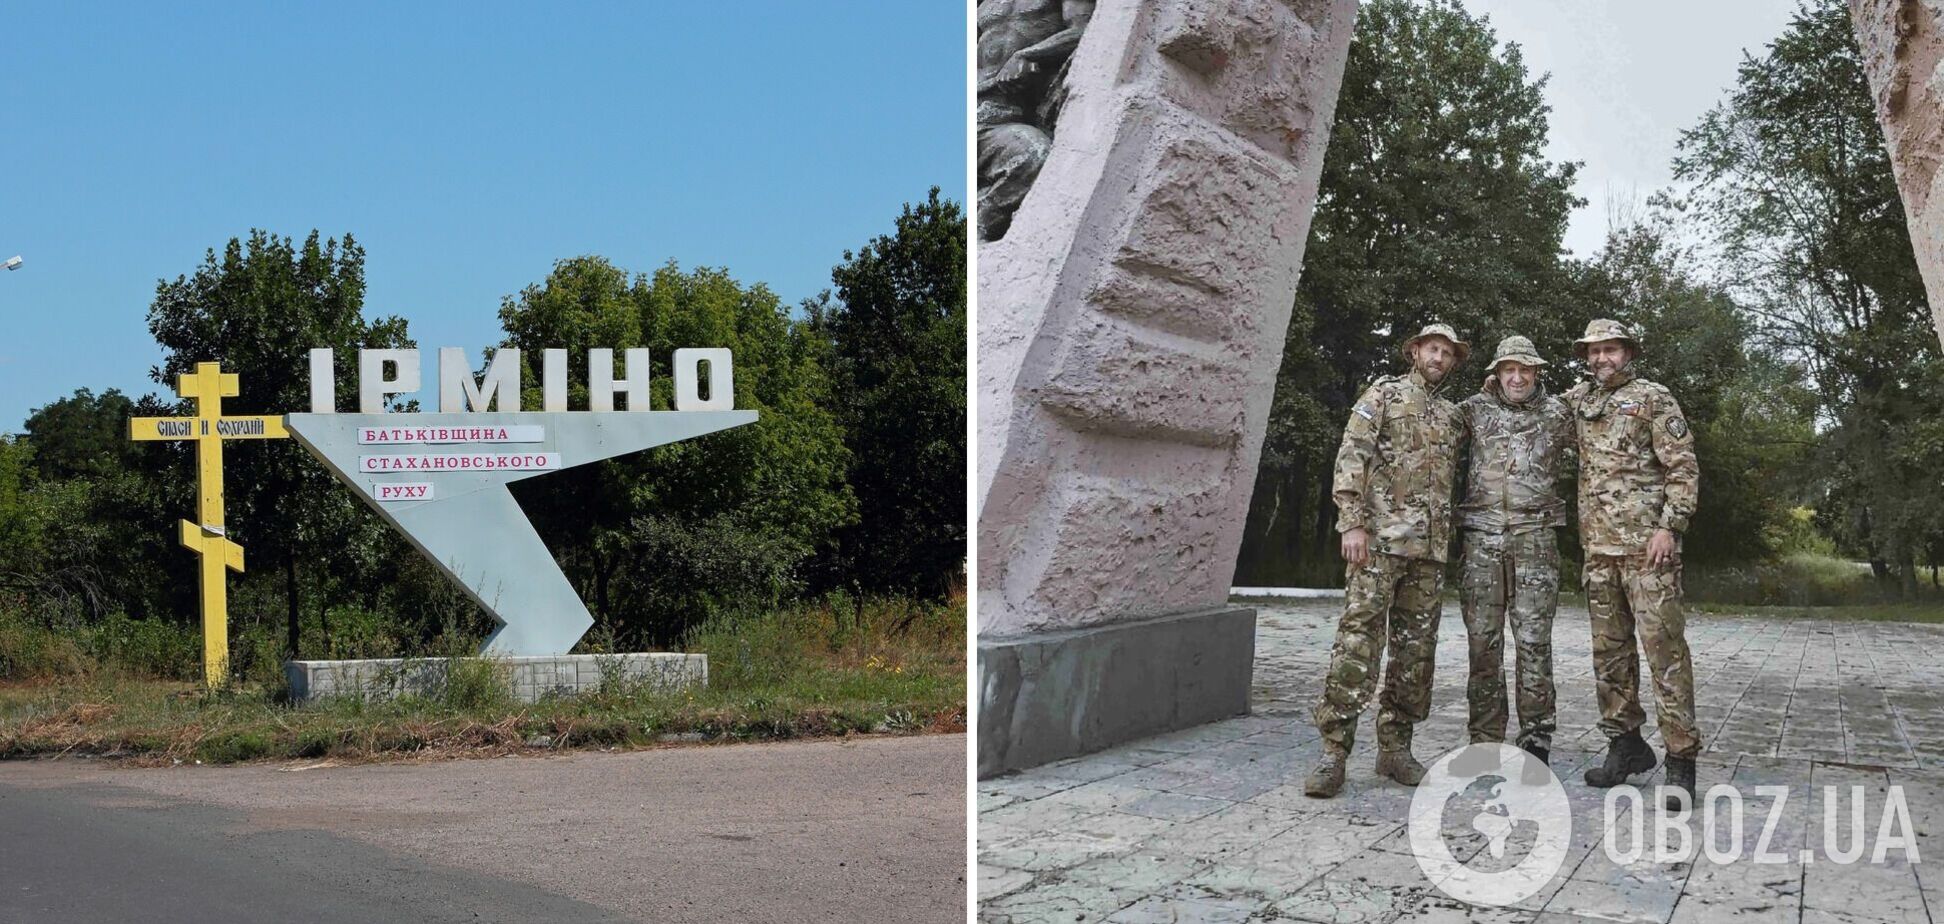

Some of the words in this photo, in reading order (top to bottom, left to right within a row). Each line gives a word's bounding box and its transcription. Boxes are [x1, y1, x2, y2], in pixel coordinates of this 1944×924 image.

[309, 347, 735, 413] ІРМІНО
[365, 428, 508, 442] БАТЬКІВЩИНА
[367, 455, 548, 470] СТАХАНОВСЬКОГО
[382, 486, 428, 499] РУХУ
